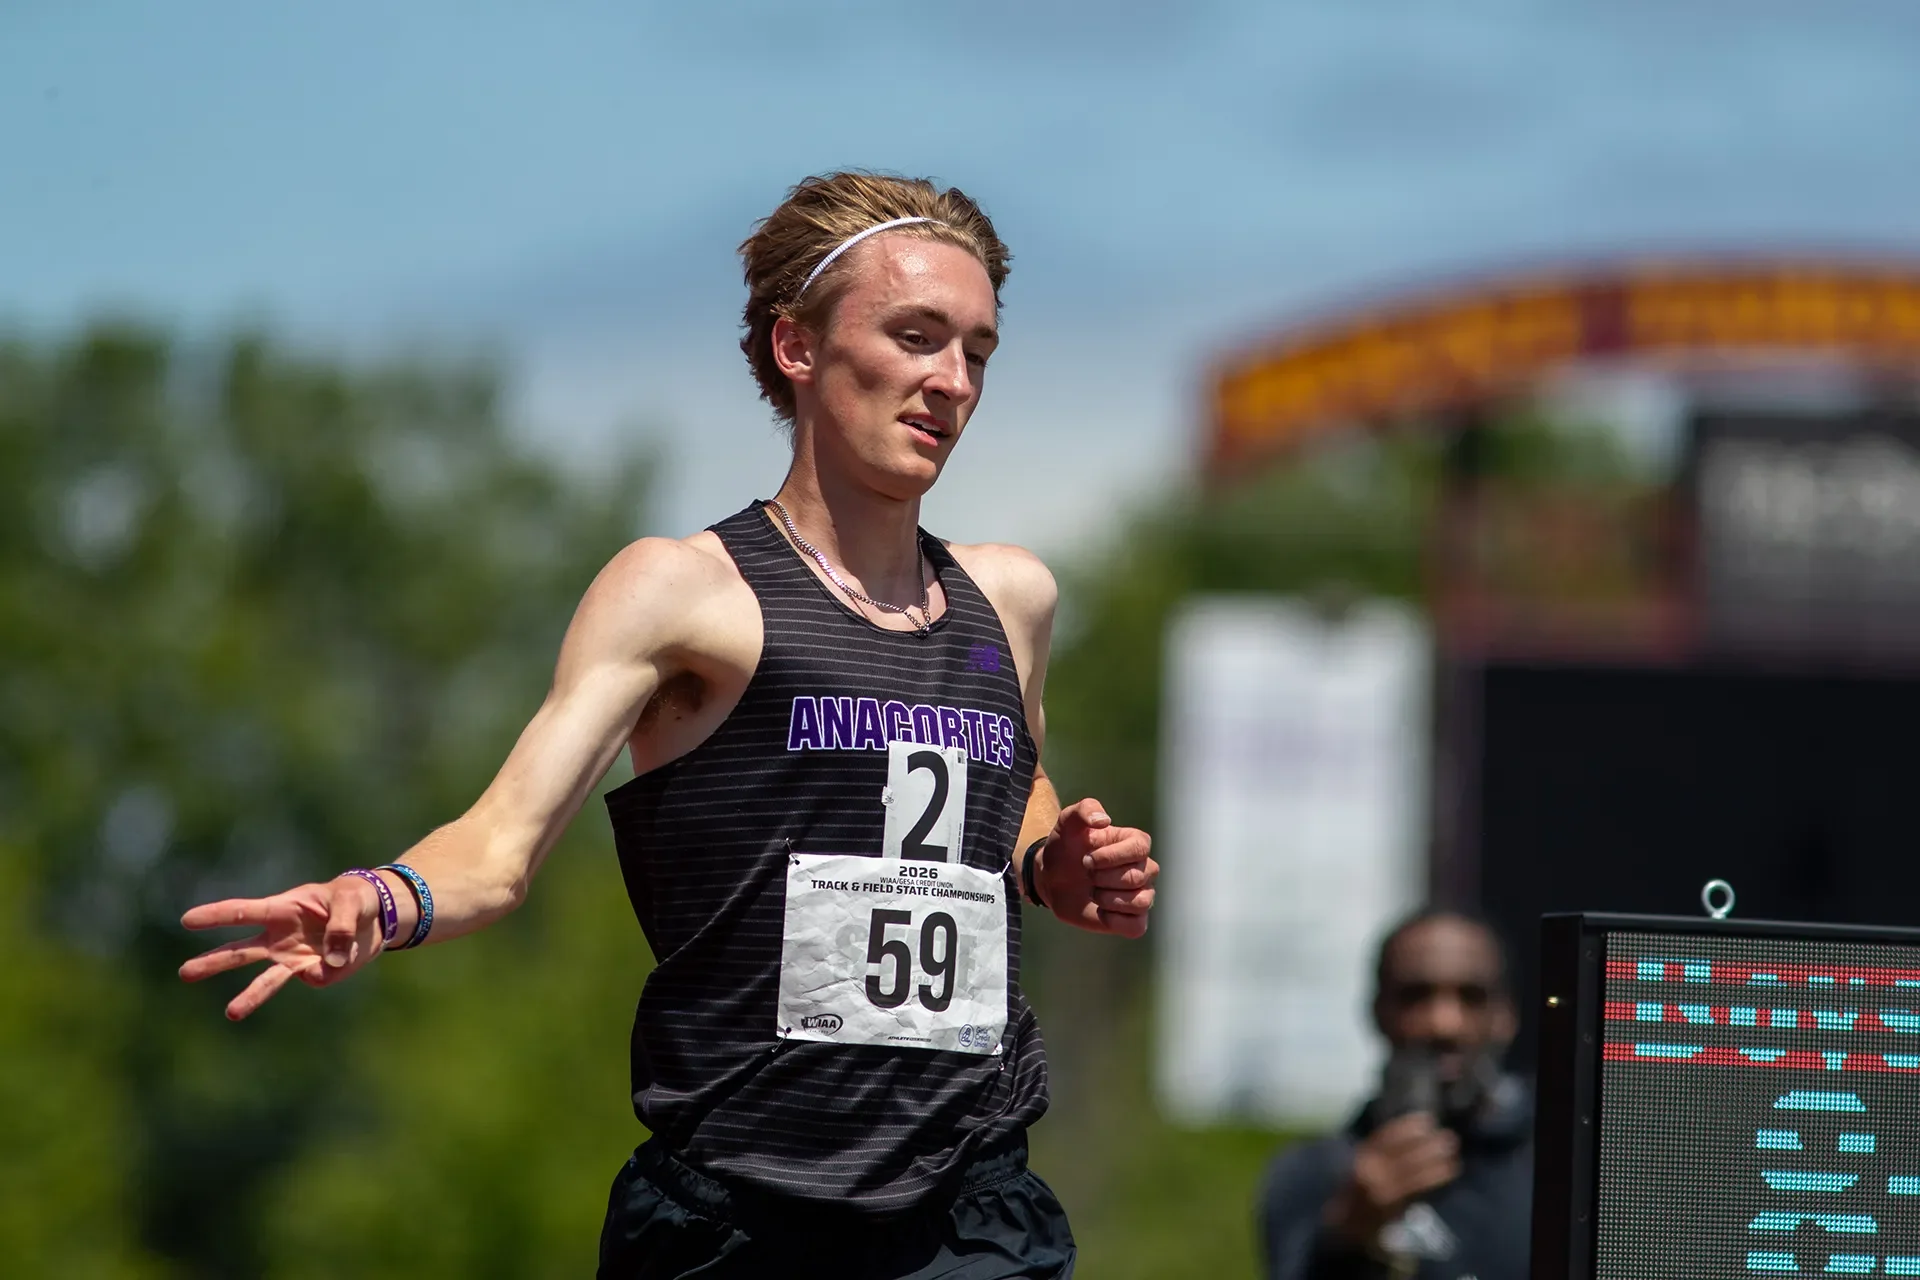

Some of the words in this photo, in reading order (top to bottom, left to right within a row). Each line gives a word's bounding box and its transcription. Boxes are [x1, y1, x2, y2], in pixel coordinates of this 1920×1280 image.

[787, 696, 1014, 769] ANACORTES
[900, 750, 949, 863] 2
[879, 877, 915, 886] WIAA/GESA
[915, 878, 936, 887] CREDIT
[936, 881, 954, 889] UNION
[899, 866, 938, 879] 2026
[375, 879, 393, 912] WIN
[811, 879, 848, 891] TRACK
[851, 882, 860, 892] &
[863, 882, 893, 894] FIELD
[896, 885, 928, 896] STATE
[931, 887, 995, 905] CHAMPIONSHIPS
[865, 908, 958, 1013] 59
[807, 1017, 837, 1029] WIAA
